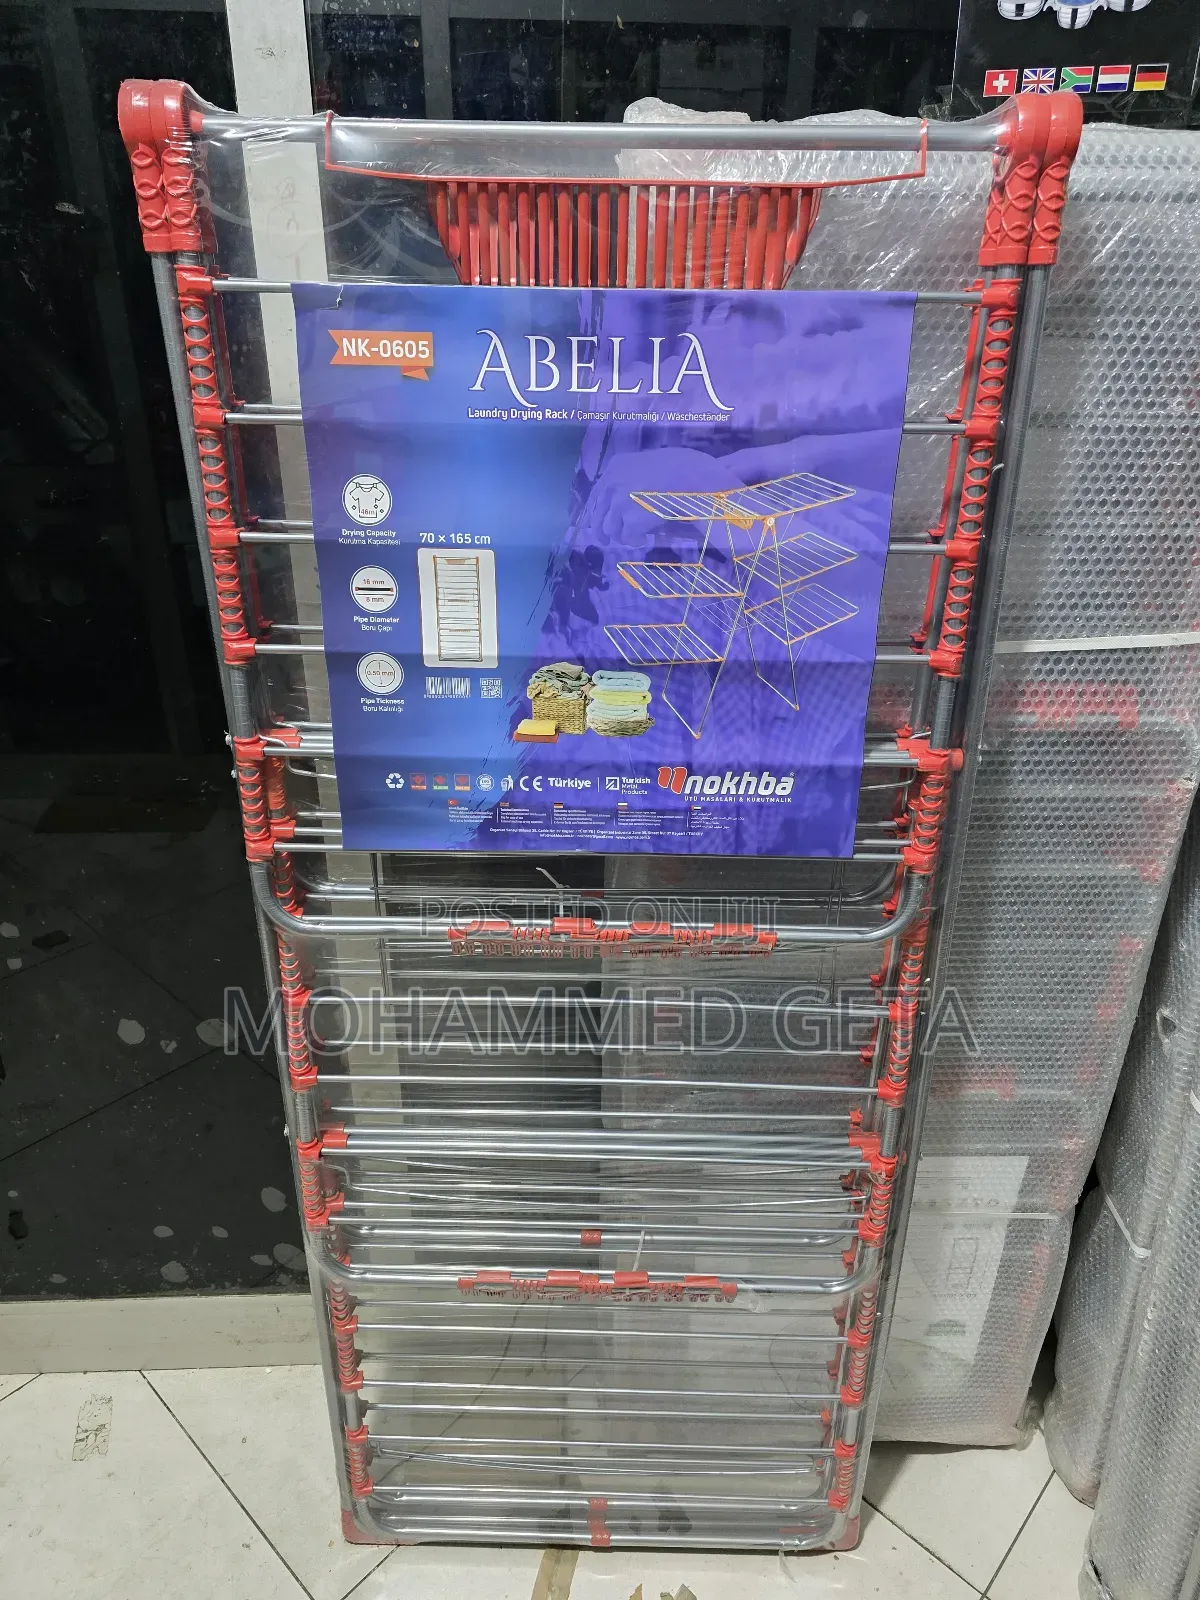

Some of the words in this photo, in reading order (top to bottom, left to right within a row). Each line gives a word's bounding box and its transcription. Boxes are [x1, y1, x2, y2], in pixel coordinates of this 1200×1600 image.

[342, 337, 430, 359] NK-0605
[468, 329, 735, 411] ABELIA
[468, 407, 508, 421] Laundry
[510, 408, 543, 421] Drying
[545, 409, 568, 419] Rack
[577, 410, 610, 423] Çamaşır
[612, 411, 659, 423] Kurutmalığı
[342, 529, 365, 537] Drying
[366, 530, 397, 538] Capacity
[419, 532, 435, 543] 70
[450, 533, 472, 544] 165
[474, 535, 491, 544] cm
[520, 775, 543, 792] CE
[547, 777, 592, 789] Türkiye
[621, 776, 651, 784] Turkish
[684, 771, 795, 796] nokhba
